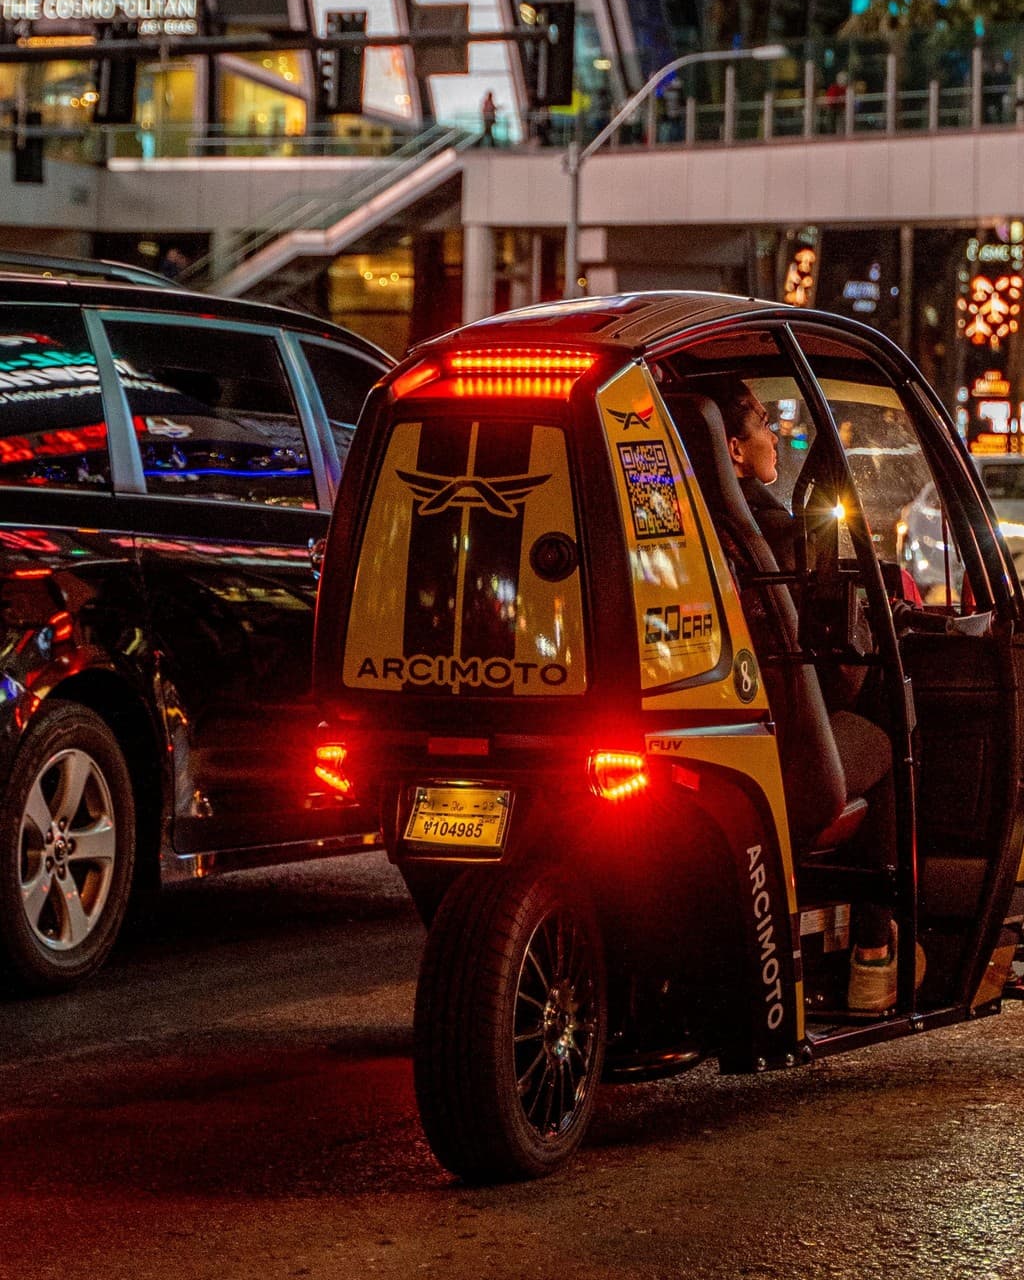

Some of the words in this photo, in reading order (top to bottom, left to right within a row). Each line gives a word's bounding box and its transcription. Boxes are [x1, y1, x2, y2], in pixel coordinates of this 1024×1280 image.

[357, 657, 568, 686] ARCIMOTO
[741, 661, 751, 692] 8
[746, 844, 783, 1030] ARCIMOTO
